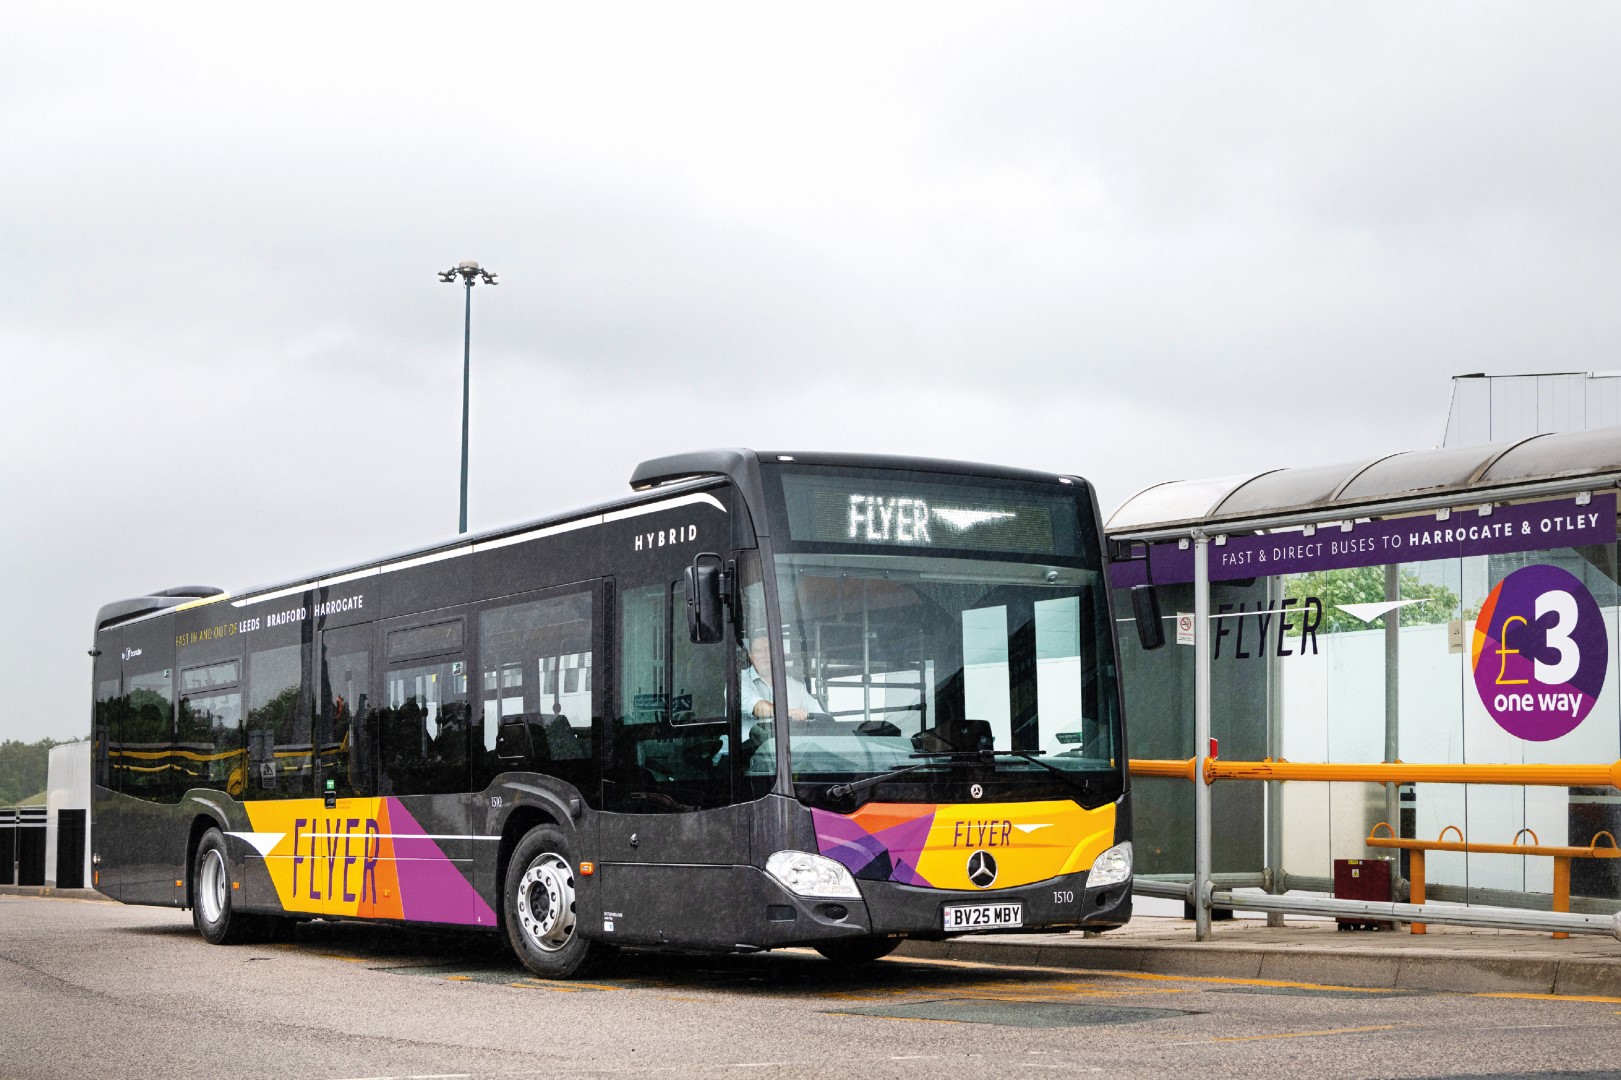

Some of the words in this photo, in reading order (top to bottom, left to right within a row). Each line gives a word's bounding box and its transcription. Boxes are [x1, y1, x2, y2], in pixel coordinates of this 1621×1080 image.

[635, 524, 697, 551] HYBRID
[848, 494, 931, 542] FLYER
[1222, 551, 1253, 566] FAST
[1259, 550, 1267, 562] &
[1273, 543, 1323, 561] DIRECT
[1331, 537, 1375, 555] BUSES
[1382, 534, 1402, 549] TO
[1409, 522, 1513, 546] HARROGATE
[1521, 520, 1531, 535] &
[1540, 512, 1599, 533] OTLEY
[175, 633, 189, 647] FAST
[190, 631, 198, 644] IN
[200, 628, 212, 641] AND
[213, 624, 227, 639] OUT
[228, 622, 238, 636] OF
[239, 617, 260, 633] LEEDS
[267, 607, 307, 627] BRADFORD
[314, 594, 363, 617] HARROGATE
[1214, 596, 1323, 660] FLYER
[1495, 589, 1581, 685] £3
[1494, 693, 1534, 712] one
[1537, 693, 1583, 718] way
[953, 819, 1012, 848] FLYER
[293, 818, 381, 905] FLYER
[954, 908, 990, 926] BV25
[994, 906, 1020, 923] MBY
[1053, 890, 1074, 904] 1510
